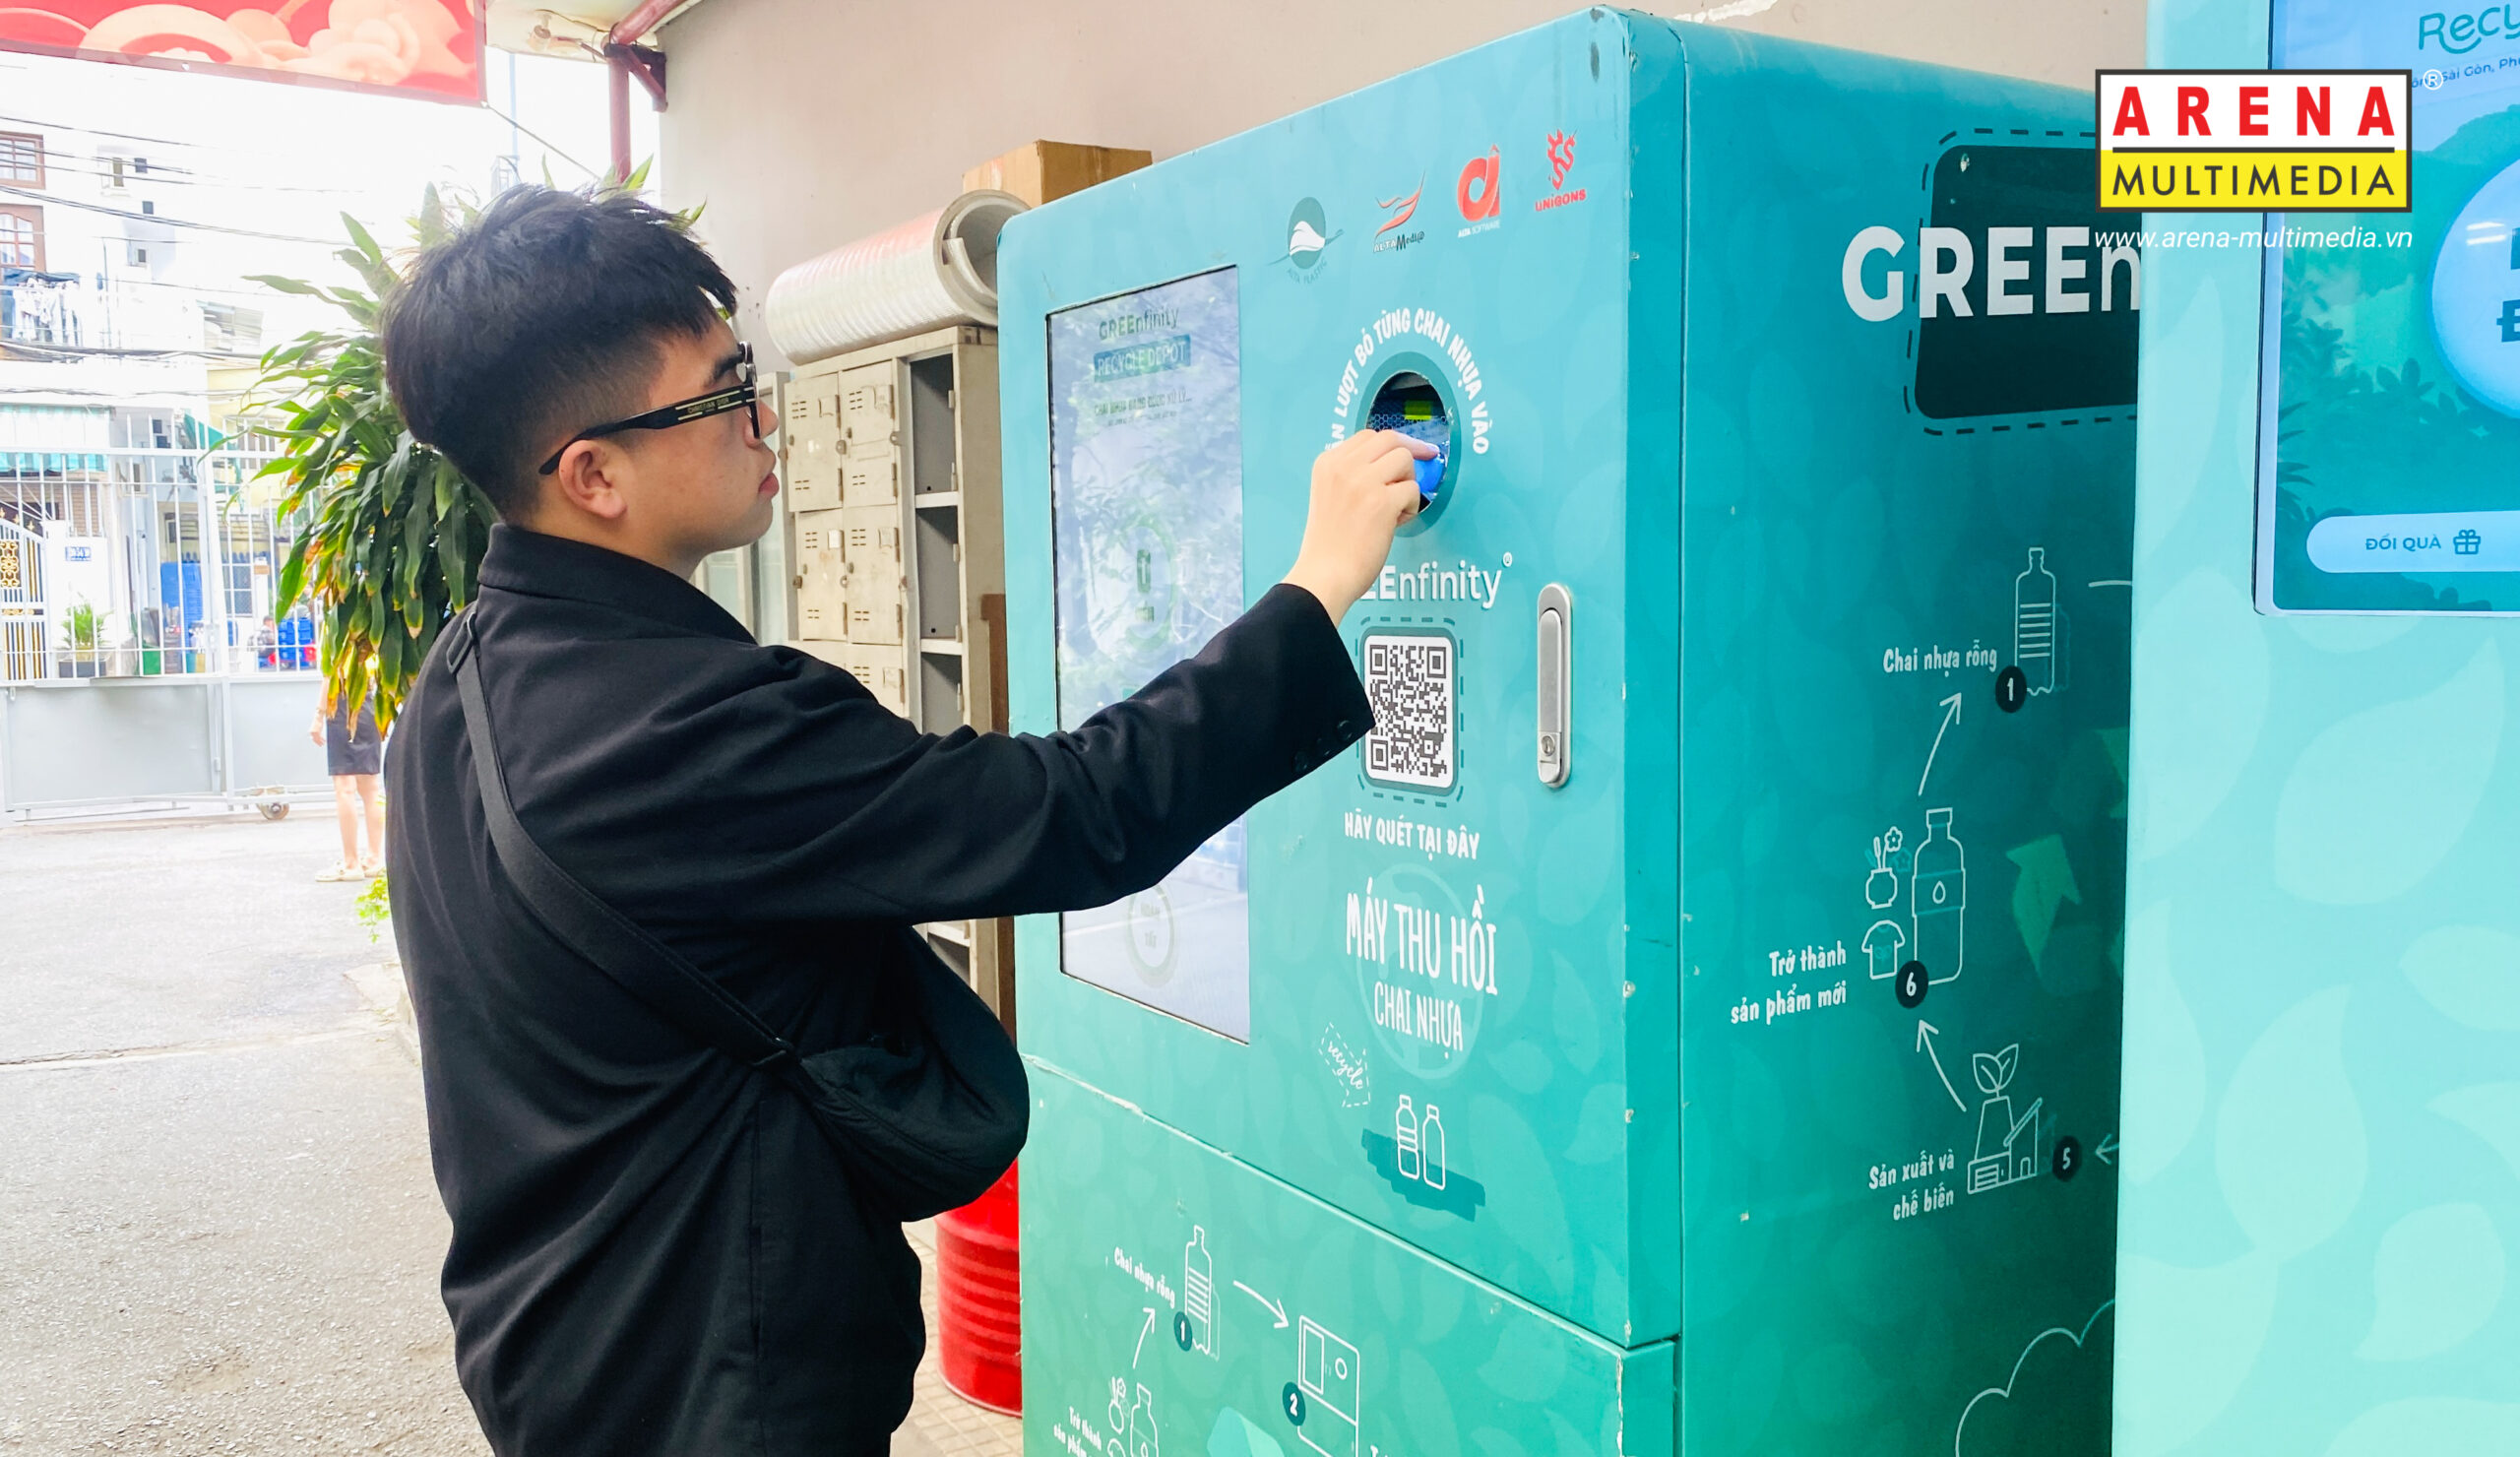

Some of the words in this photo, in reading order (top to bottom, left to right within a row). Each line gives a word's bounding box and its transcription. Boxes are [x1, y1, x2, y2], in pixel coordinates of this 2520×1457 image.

[1414, 307, 1451, 348] CHAI
[1447, 334, 1483, 402] NHỰA
[2403, 534, 2442, 551] QUÀ
[1883, 647, 1919, 673] Chai
[1923, 644, 1960, 678] nhựa
[1966, 638, 1997, 673] rỗng
[2006, 676, 2014, 702] 1
[1375, 814, 1414, 849] QUÉT
[1417, 823, 1442, 861] TẠI
[1446, 824, 1480, 860] ĐÂY
[1346, 876, 1388, 966] MÁY
[1393, 903, 1441, 980] THU
[1450, 883, 1498, 997] HỒI
[1769, 949, 1796, 978] Trở
[1799, 940, 1847, 972] thành
[1731, 996, 1760, 1025] sản
[1766, 983, 1811, 1026] phẩm
[1817, 980, 1847, 1008] mới
[1906, 971, 1918, 997] 6
[1374, 981, 1413, 1036] CHAI
[1417, 993, 1464, 1060] NHỰA
[1869, 1163, 1897, 1190] Sản
[1902, 1150, 1934, 1182] xuất
[1938, 1148, 1955, 1172] và
[2061, 1147, 2071, 1171] 5
[1893, 1188, 1919, 1221] chế
[1923, 1181, 1954, 1213] biến
[1179, 1320, 1186, 1342] 1
[1290, 1392, 1299, 1417] 2
